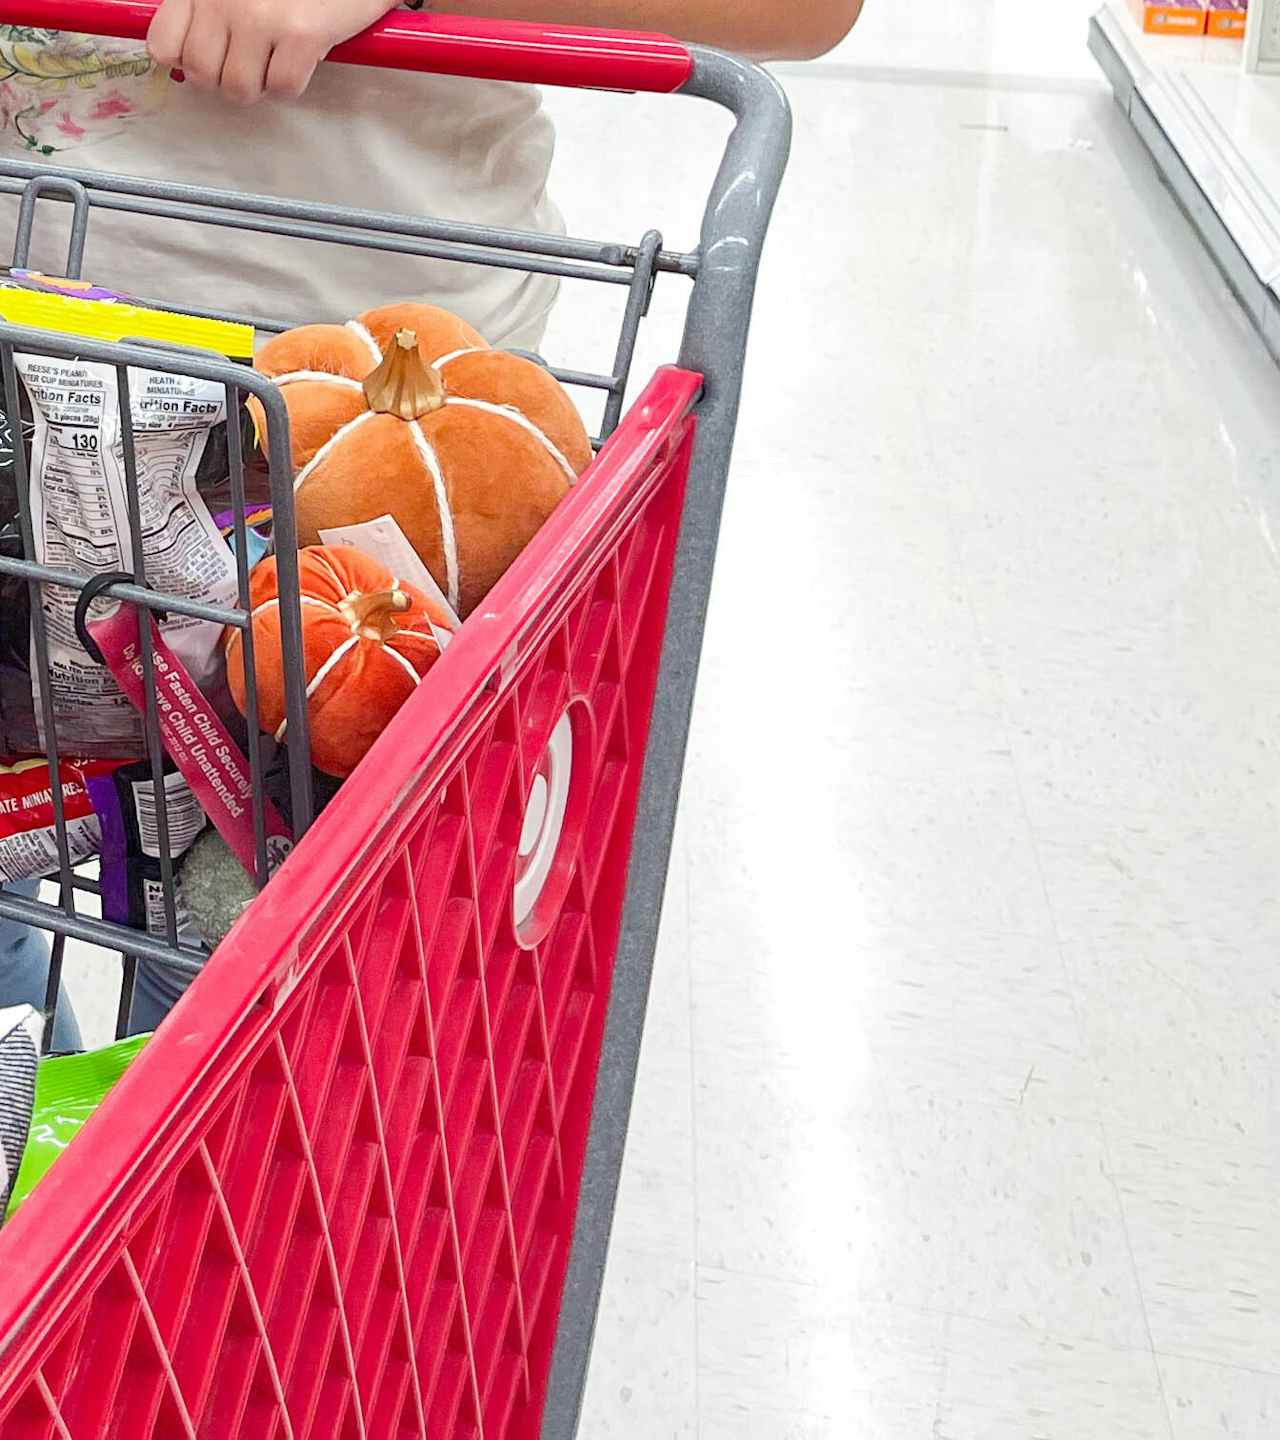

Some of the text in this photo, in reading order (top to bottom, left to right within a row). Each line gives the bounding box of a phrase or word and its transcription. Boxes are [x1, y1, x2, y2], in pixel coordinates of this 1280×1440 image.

[27, 363, 59, 376] REESE'S
[40, 375, 57, 385] CUP
[149, 375, 176, 386] HEATH
[67, 391, 102, 405] Facts
[182, 400, 218, 414] Facts
[71, 433, 98, 451] 130
[165, 664, 198, 716] Fasten
[194, 712, 221, 746] Child
[215, 744, 254, 801] Securely
[168, 710, 193, 744] Child
[191, 742, 244, 819] Unattended
